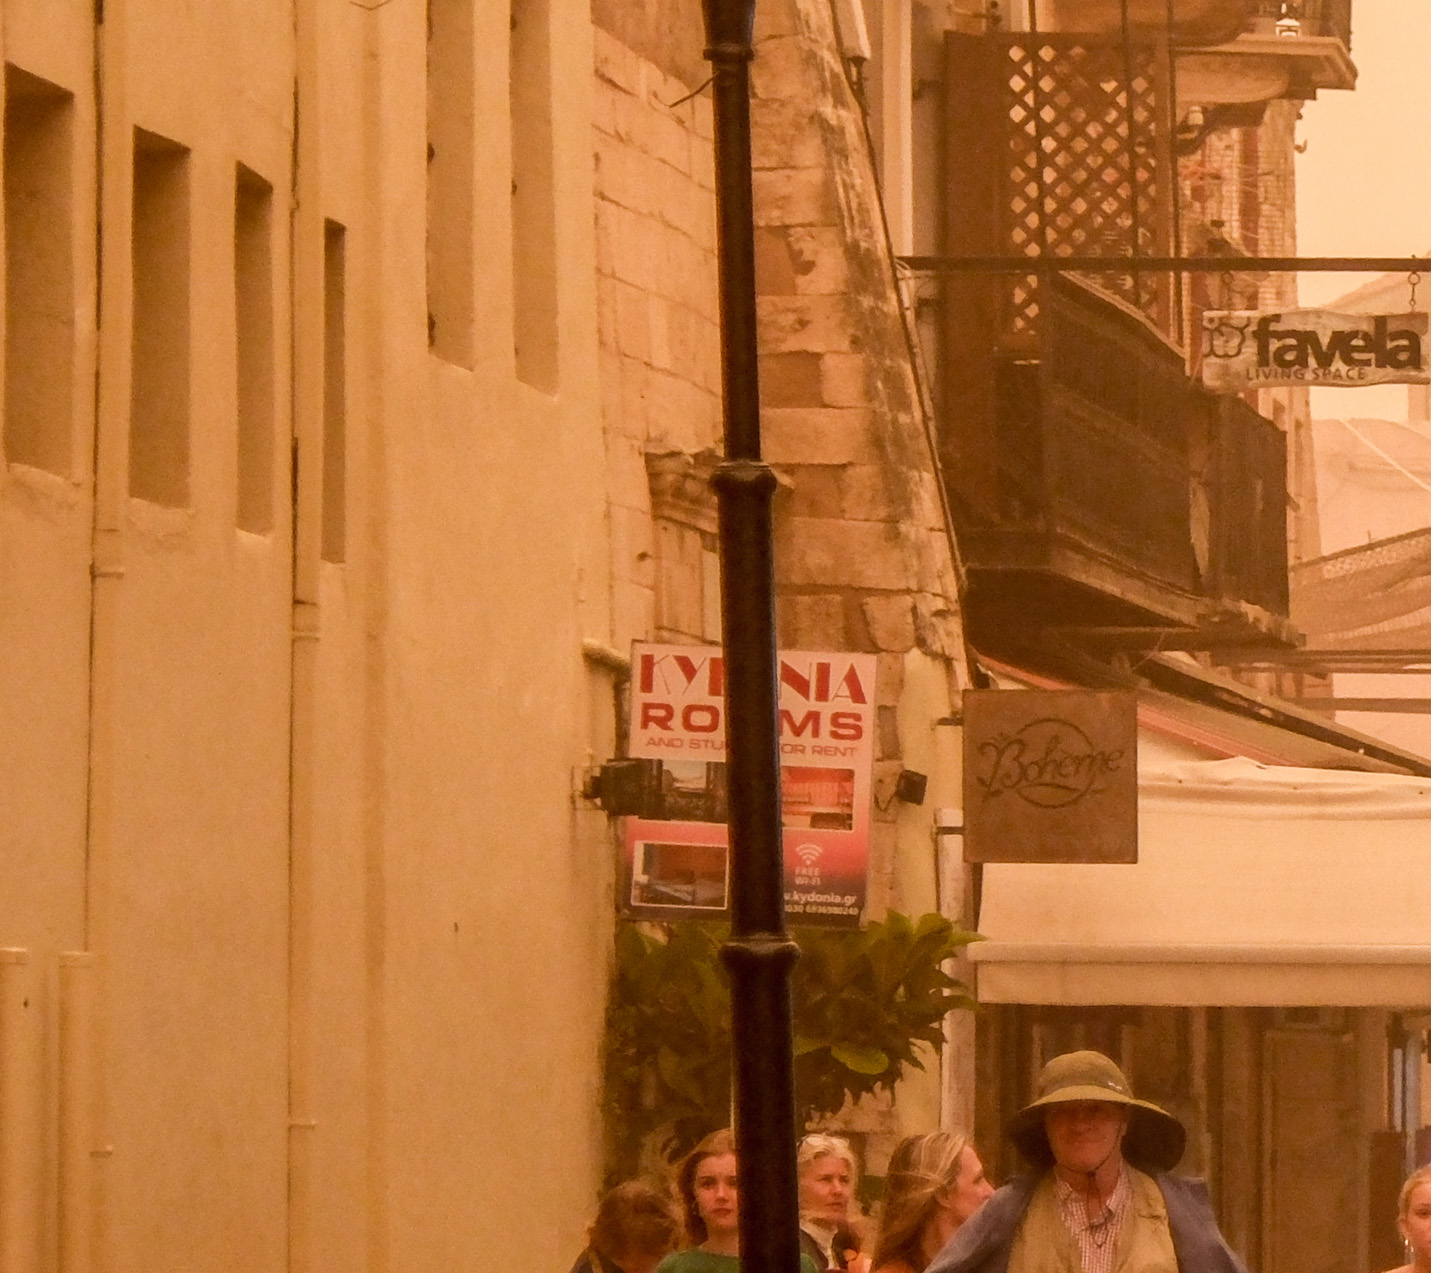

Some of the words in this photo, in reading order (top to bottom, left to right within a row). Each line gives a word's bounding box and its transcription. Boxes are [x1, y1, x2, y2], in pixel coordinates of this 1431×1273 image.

[1252, 313, 1422, 370] favela
[1245, 367, 1306, 381] LIVING
[1311, 367, 1368, 381] SPACE
[639, 702, 864, 742] ROMS
[645, 736, 683, 749] AND
[811, 744, 858, 757] RENT
